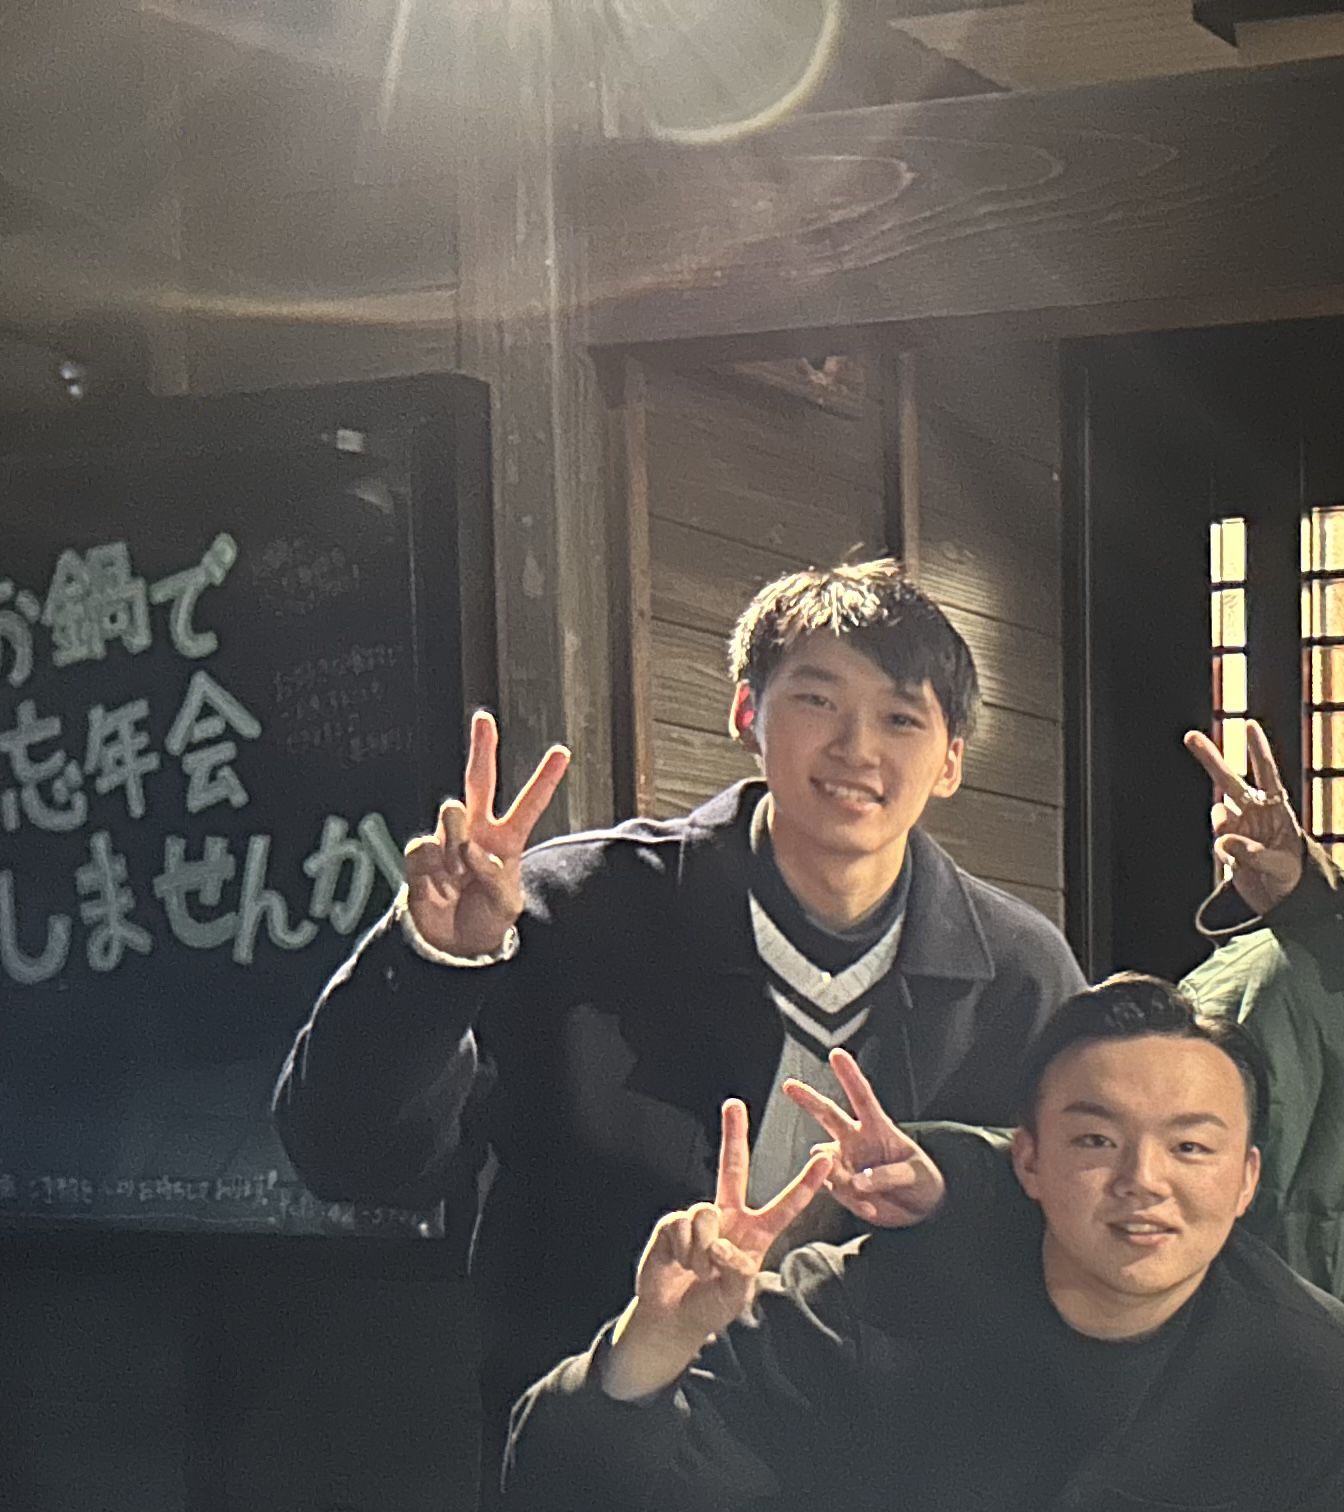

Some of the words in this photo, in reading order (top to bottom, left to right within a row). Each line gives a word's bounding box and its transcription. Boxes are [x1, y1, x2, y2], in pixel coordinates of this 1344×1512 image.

[0, 670, 261, 832] 忘年会
[0, 812, 406, 985] しませんか
